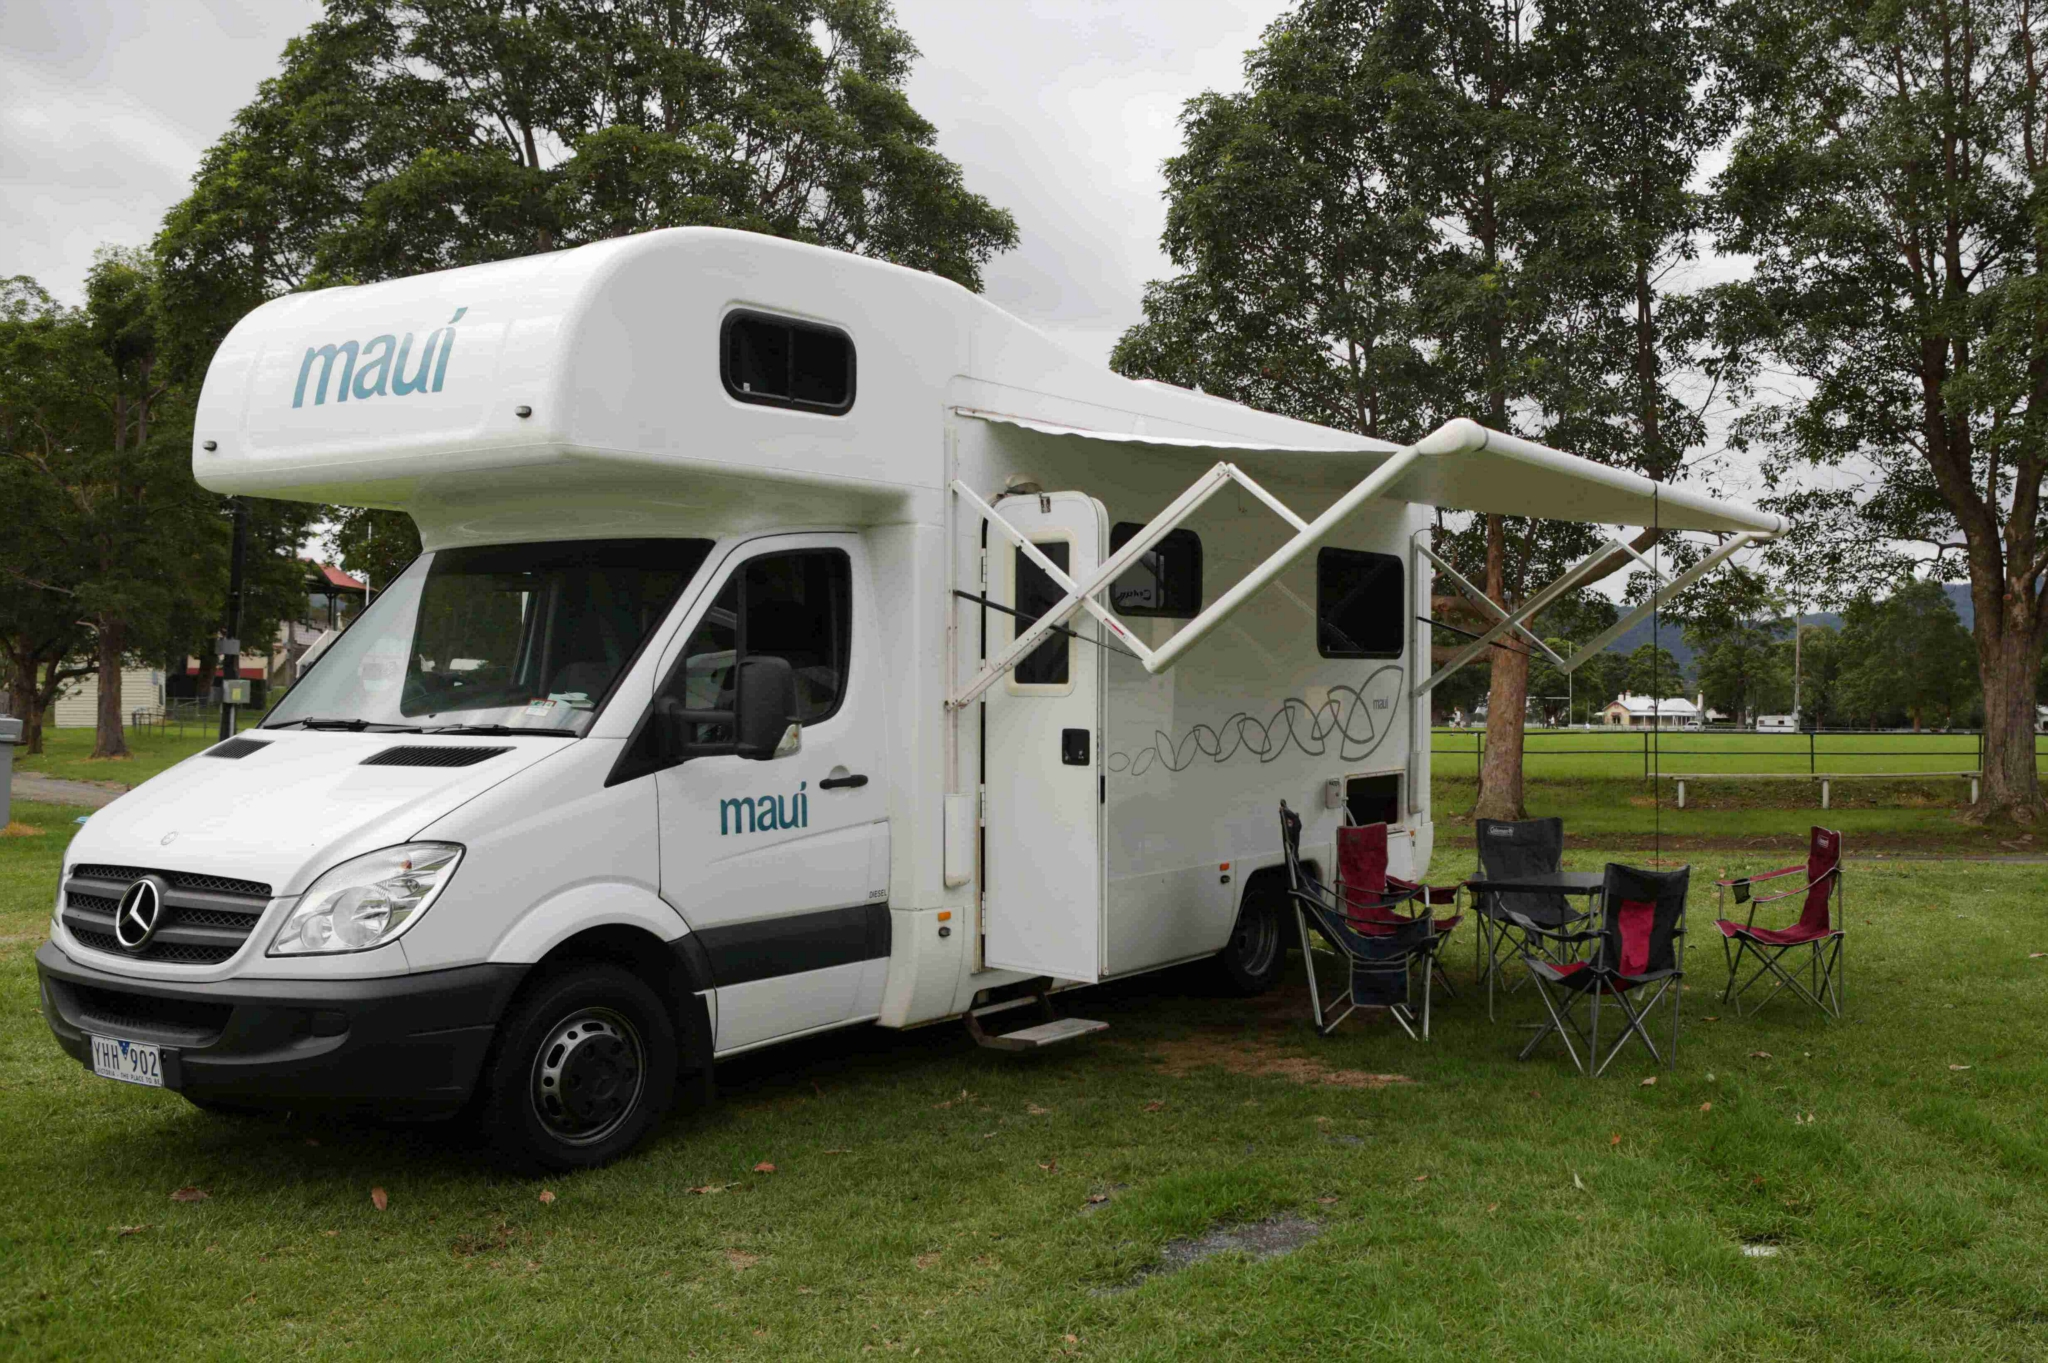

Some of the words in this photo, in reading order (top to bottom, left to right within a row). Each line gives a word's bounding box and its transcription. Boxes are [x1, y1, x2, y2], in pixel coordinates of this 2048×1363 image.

[869, 889, 887, 899] DIESEL
[93, 1041, 120, 1069] YHH
[130, 1047, 159, 1077] 902
[97, 1067, 115, 1076] VICTORIA
[131, 1075, 144, 1083] PLACE
